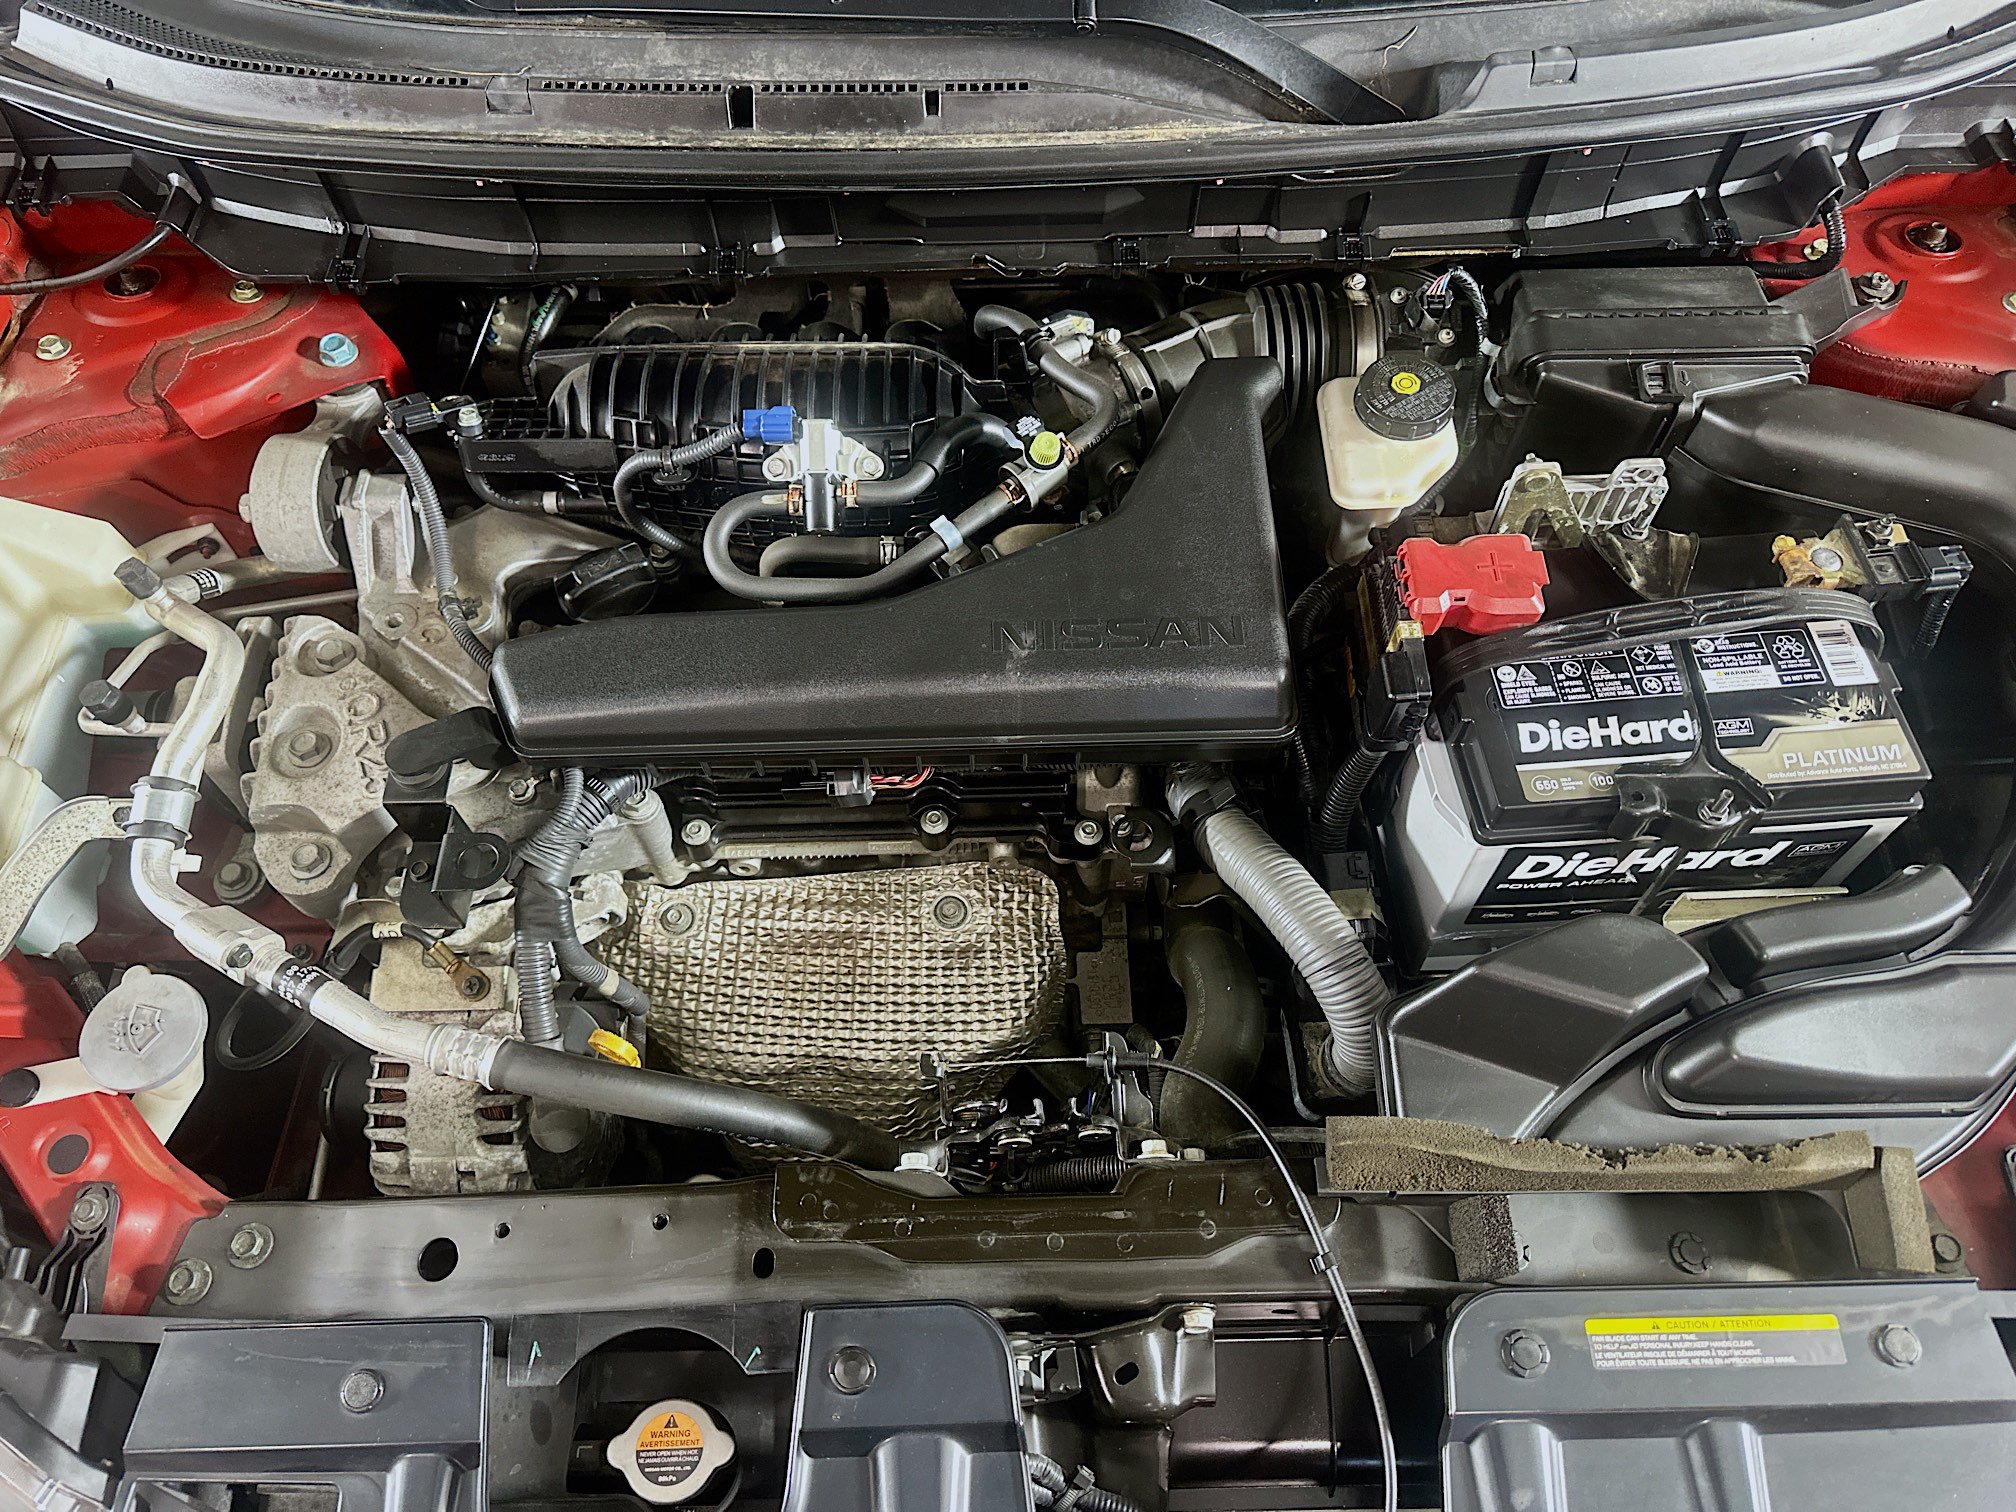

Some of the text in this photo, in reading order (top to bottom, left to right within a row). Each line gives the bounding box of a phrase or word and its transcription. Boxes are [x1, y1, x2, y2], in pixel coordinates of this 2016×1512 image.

[992, 615, 1247, 652] NISSAN
[1716, 641, 1759, 651] INSTRUCTIONS.
[1701, 652, 1764, 664] NON-SPILLABLE
[1708, 659, 1762, 669] Lead Acid Battery
[1716, 720, 1750, 731] AGM
[1516, 709, 1694, 754] DieHard
[1782, 743, 1902, 769] PLATINUM
[1767, 771, 1796, 779] Distributed
[1806, 768, 1829, 776] Advance
[1535, 779, 1559, 791] 650
[1591, 775, 1614, 787] 100
[1507, 840, 1794, 880] DieHard
[1496, 877, 1632, 890] POWER AHEAD
[1666, 1320, 1709, 1329] CAUTION
[1719, 1319, 1771, 1328] ATTENTION
[1639, 1341, 1672, 1349] PERSONAL
[1603, 1351, 1643, 1359] VENTILATEUR
[1643, 1350, 1667, 1358] RISQUE
[1724, 1356, 1762, 1364] APPROCHER
[651, 1430, 691, 1439] WARNING
[640, 1439, 700, 1448] AVERTISSEMENT
